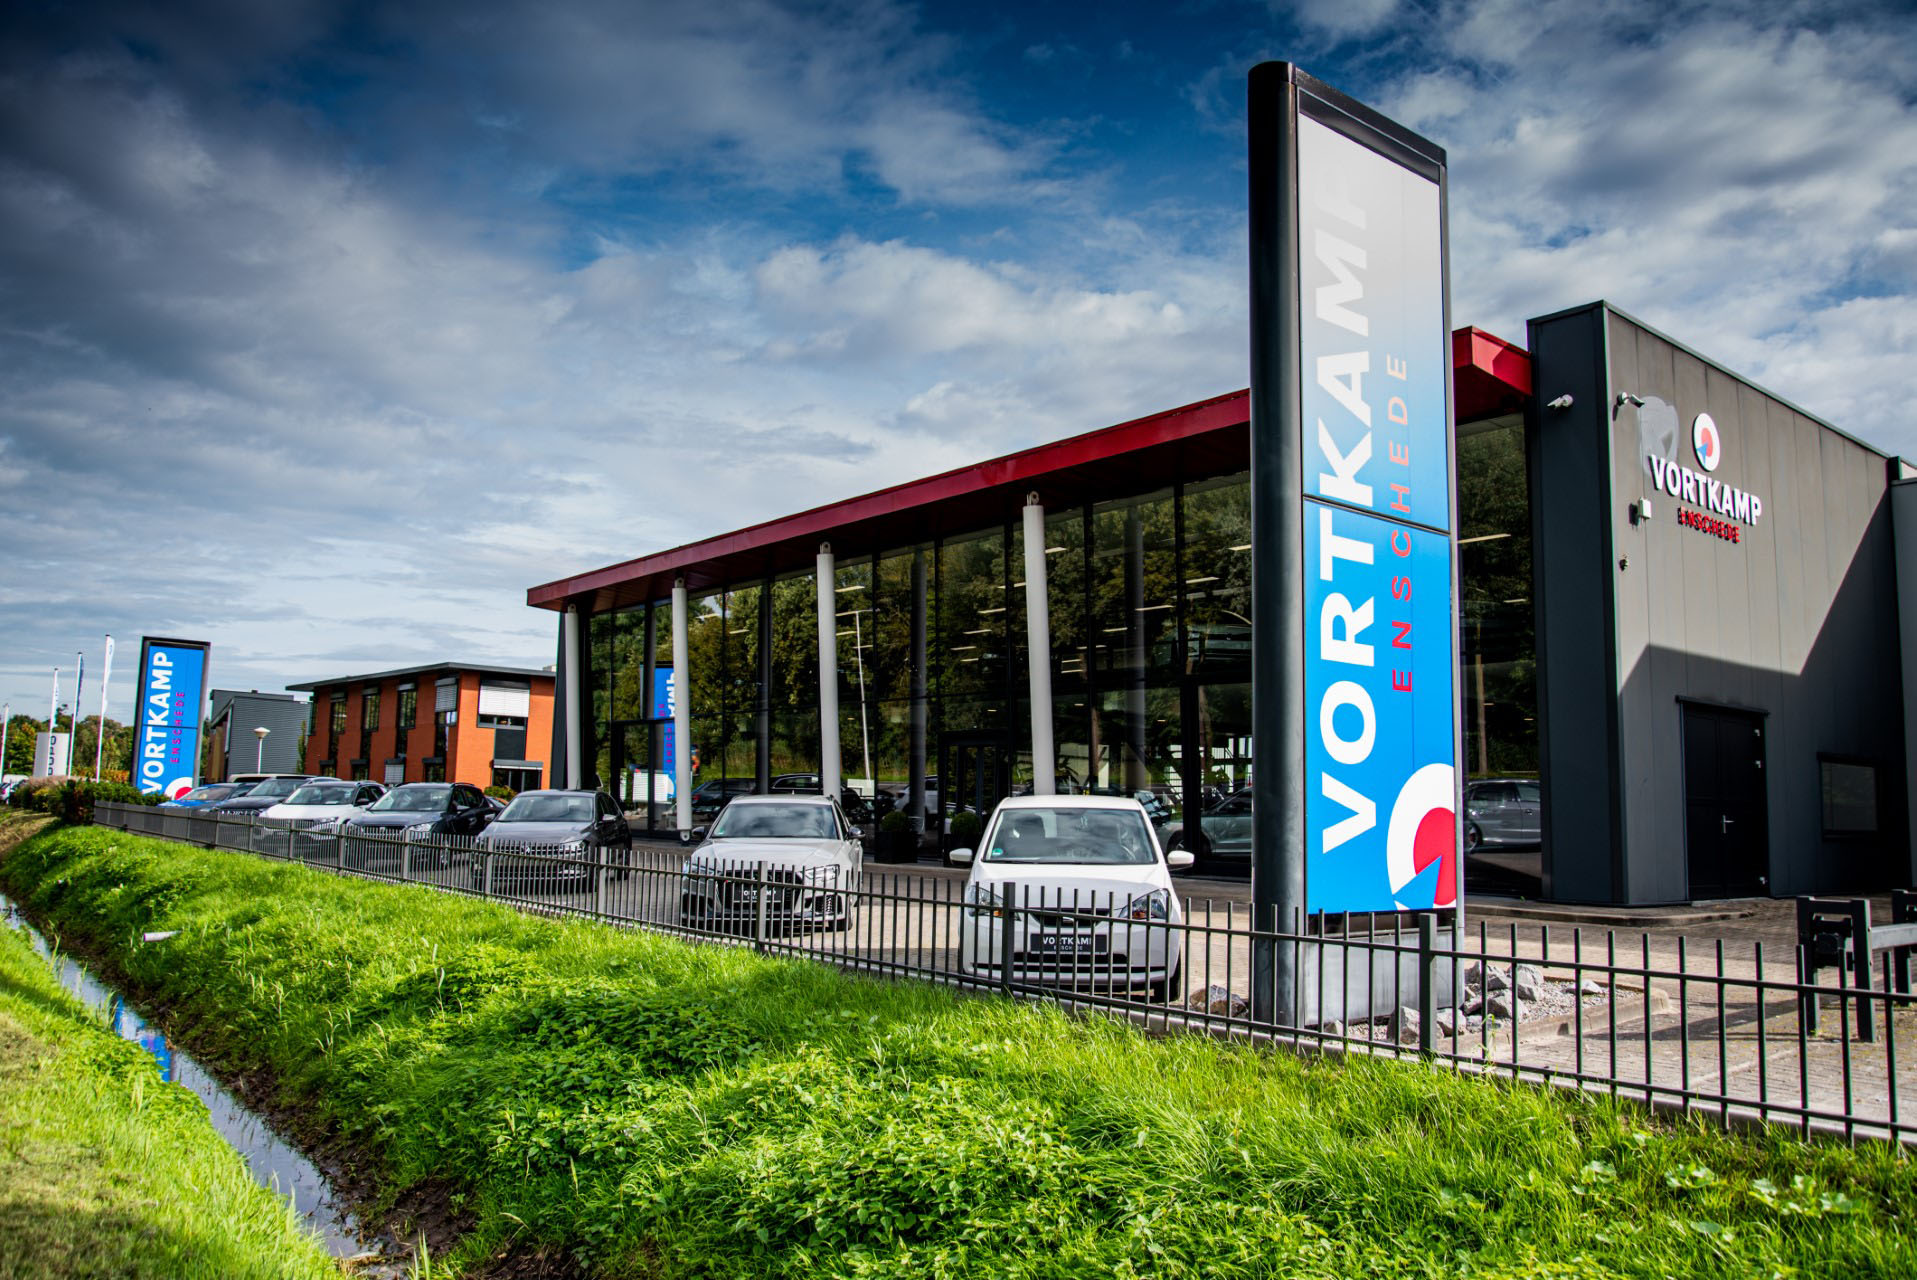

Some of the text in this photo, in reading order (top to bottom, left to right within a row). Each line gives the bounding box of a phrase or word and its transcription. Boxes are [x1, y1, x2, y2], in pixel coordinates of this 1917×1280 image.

[1315, 160, 1376, 853] VORTKAMP
[1387, 353, 1413, 692] ENSCHEDE
[1649, 454, 1762, 526] VORTKAMP
[1678, 506, 1740, 543] ENSCHEDE
[142, 652, 173, 795] VORTKAMP
[170, 692, 185, 763] ENSCHEDE
[1042, 937, 1092, 945] VOTKM
